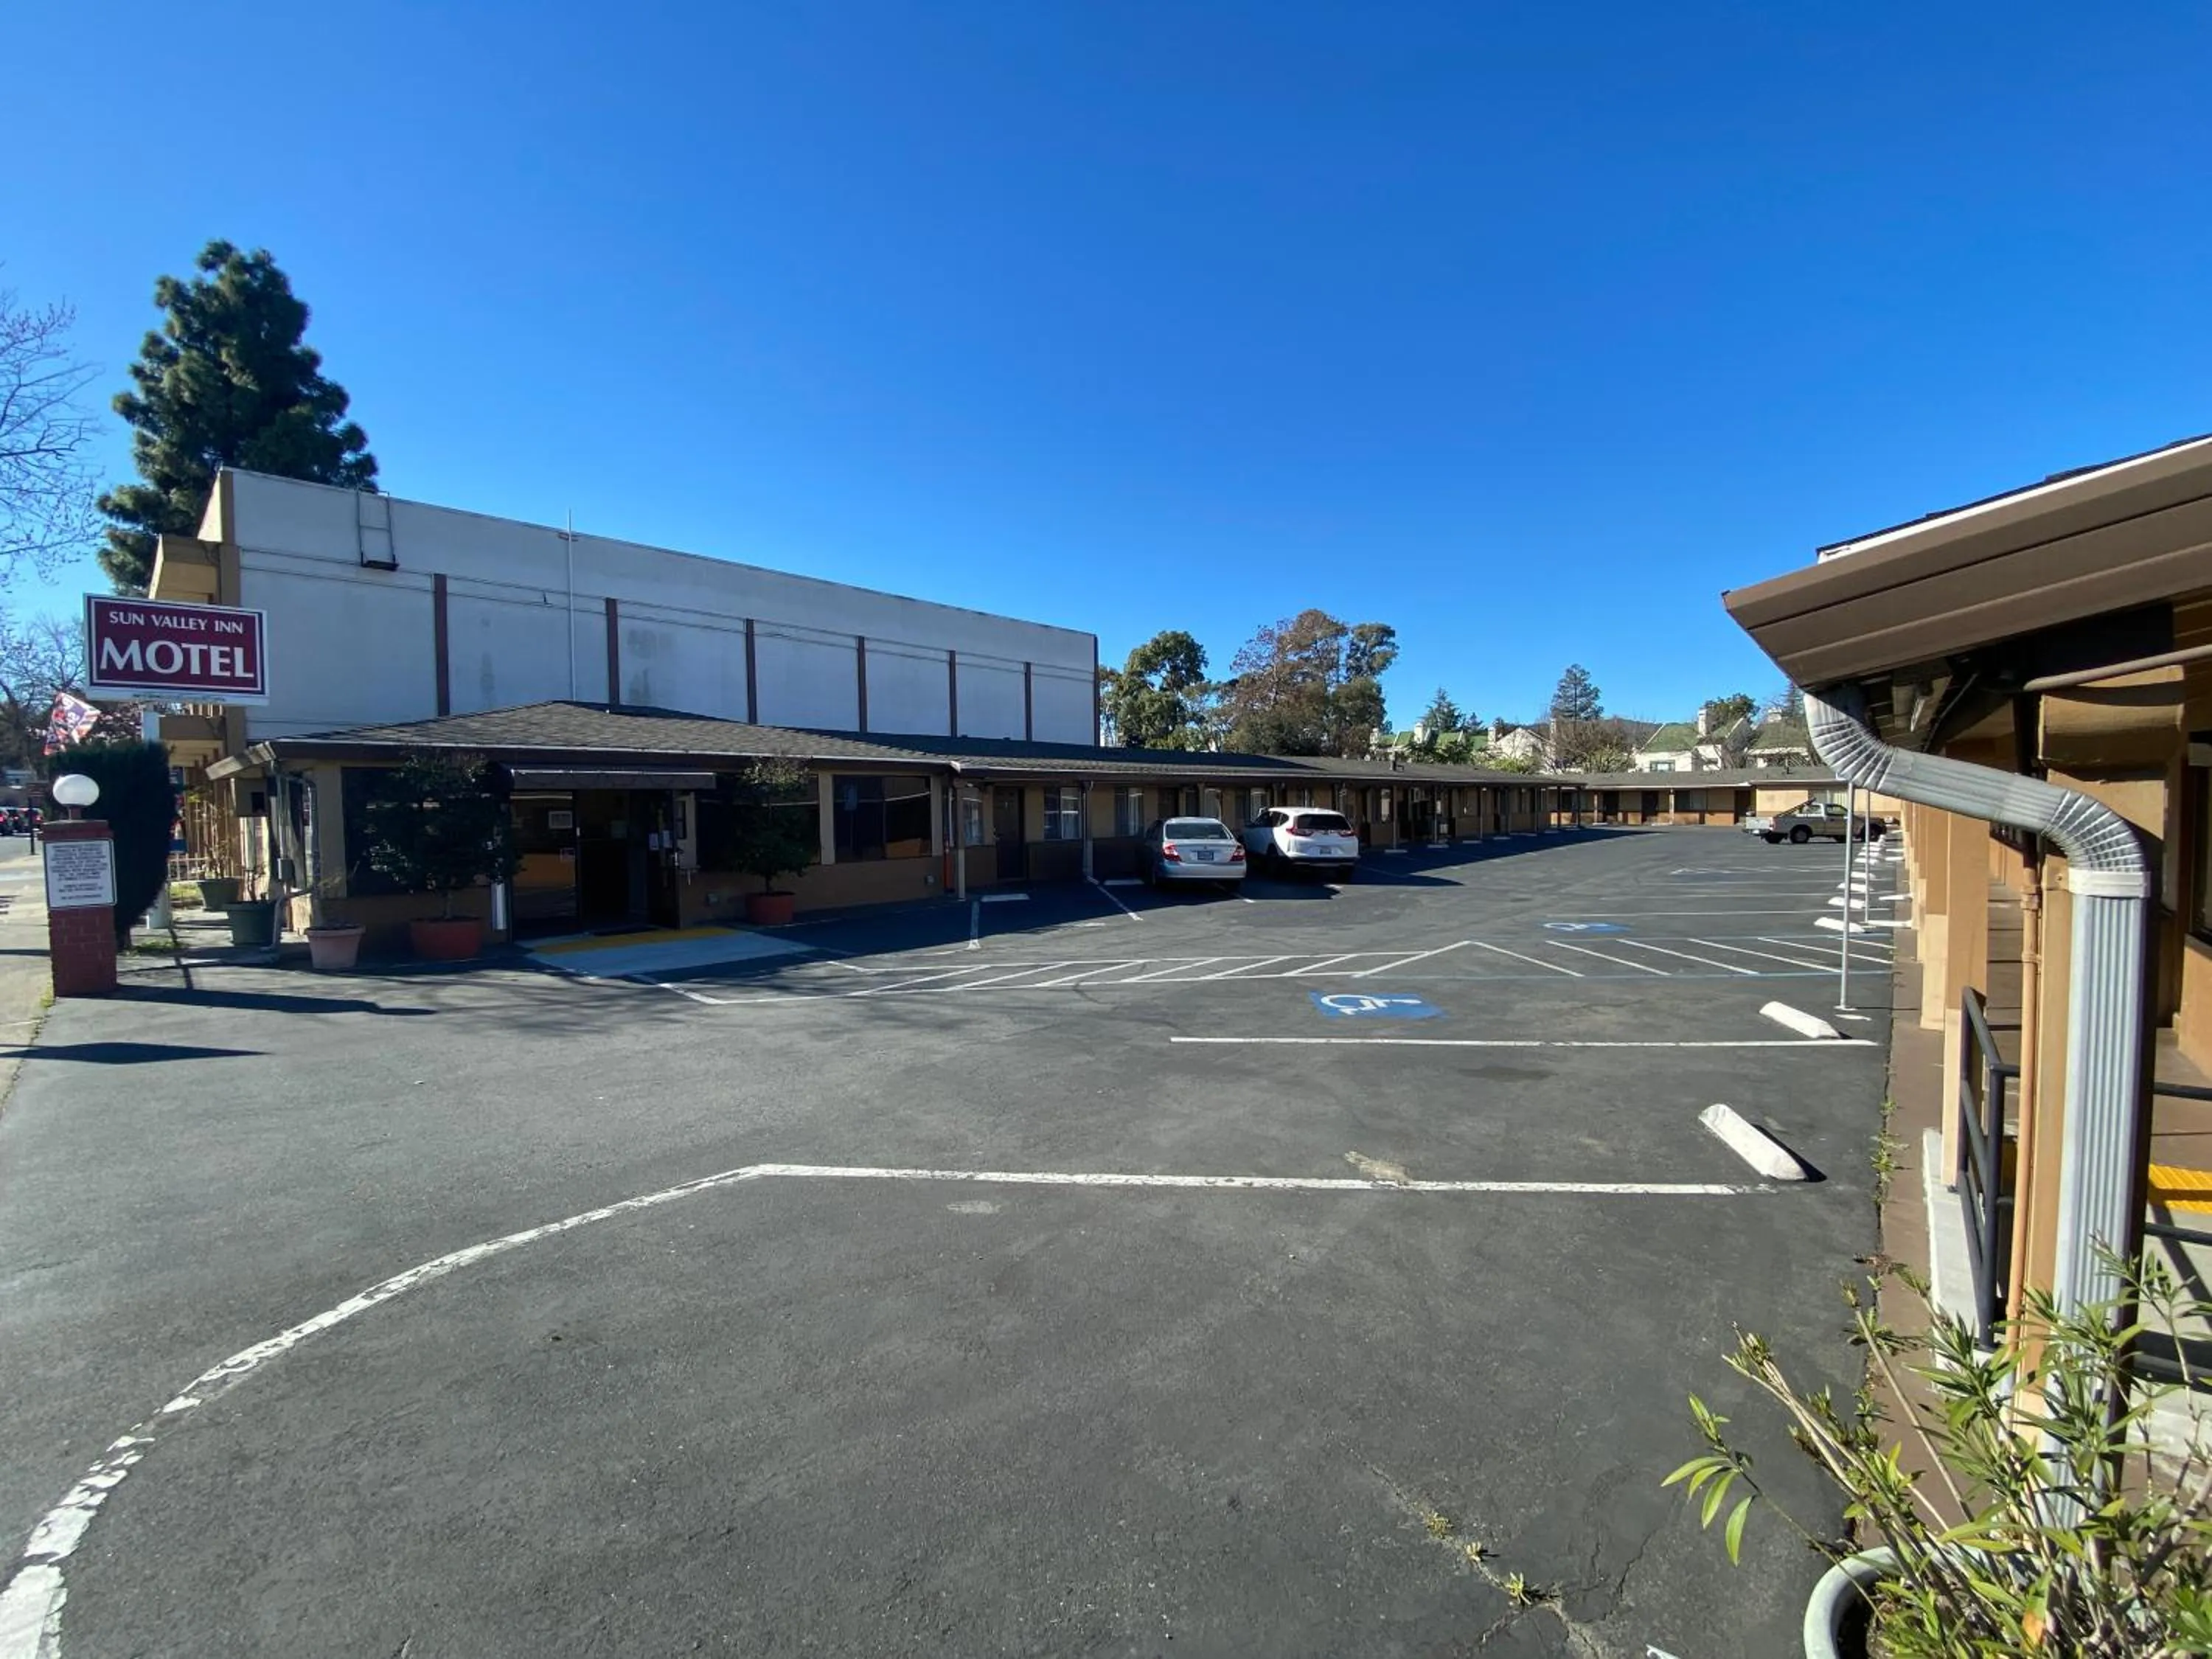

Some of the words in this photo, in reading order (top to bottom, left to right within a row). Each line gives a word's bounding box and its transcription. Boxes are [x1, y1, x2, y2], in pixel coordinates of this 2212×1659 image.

[110, 611, 145, 626] SUN
[151, 614, 209, 630] VALLEY
[215, 620, 243, 633] INN
[100, 637, 254, 678] MOTEL
